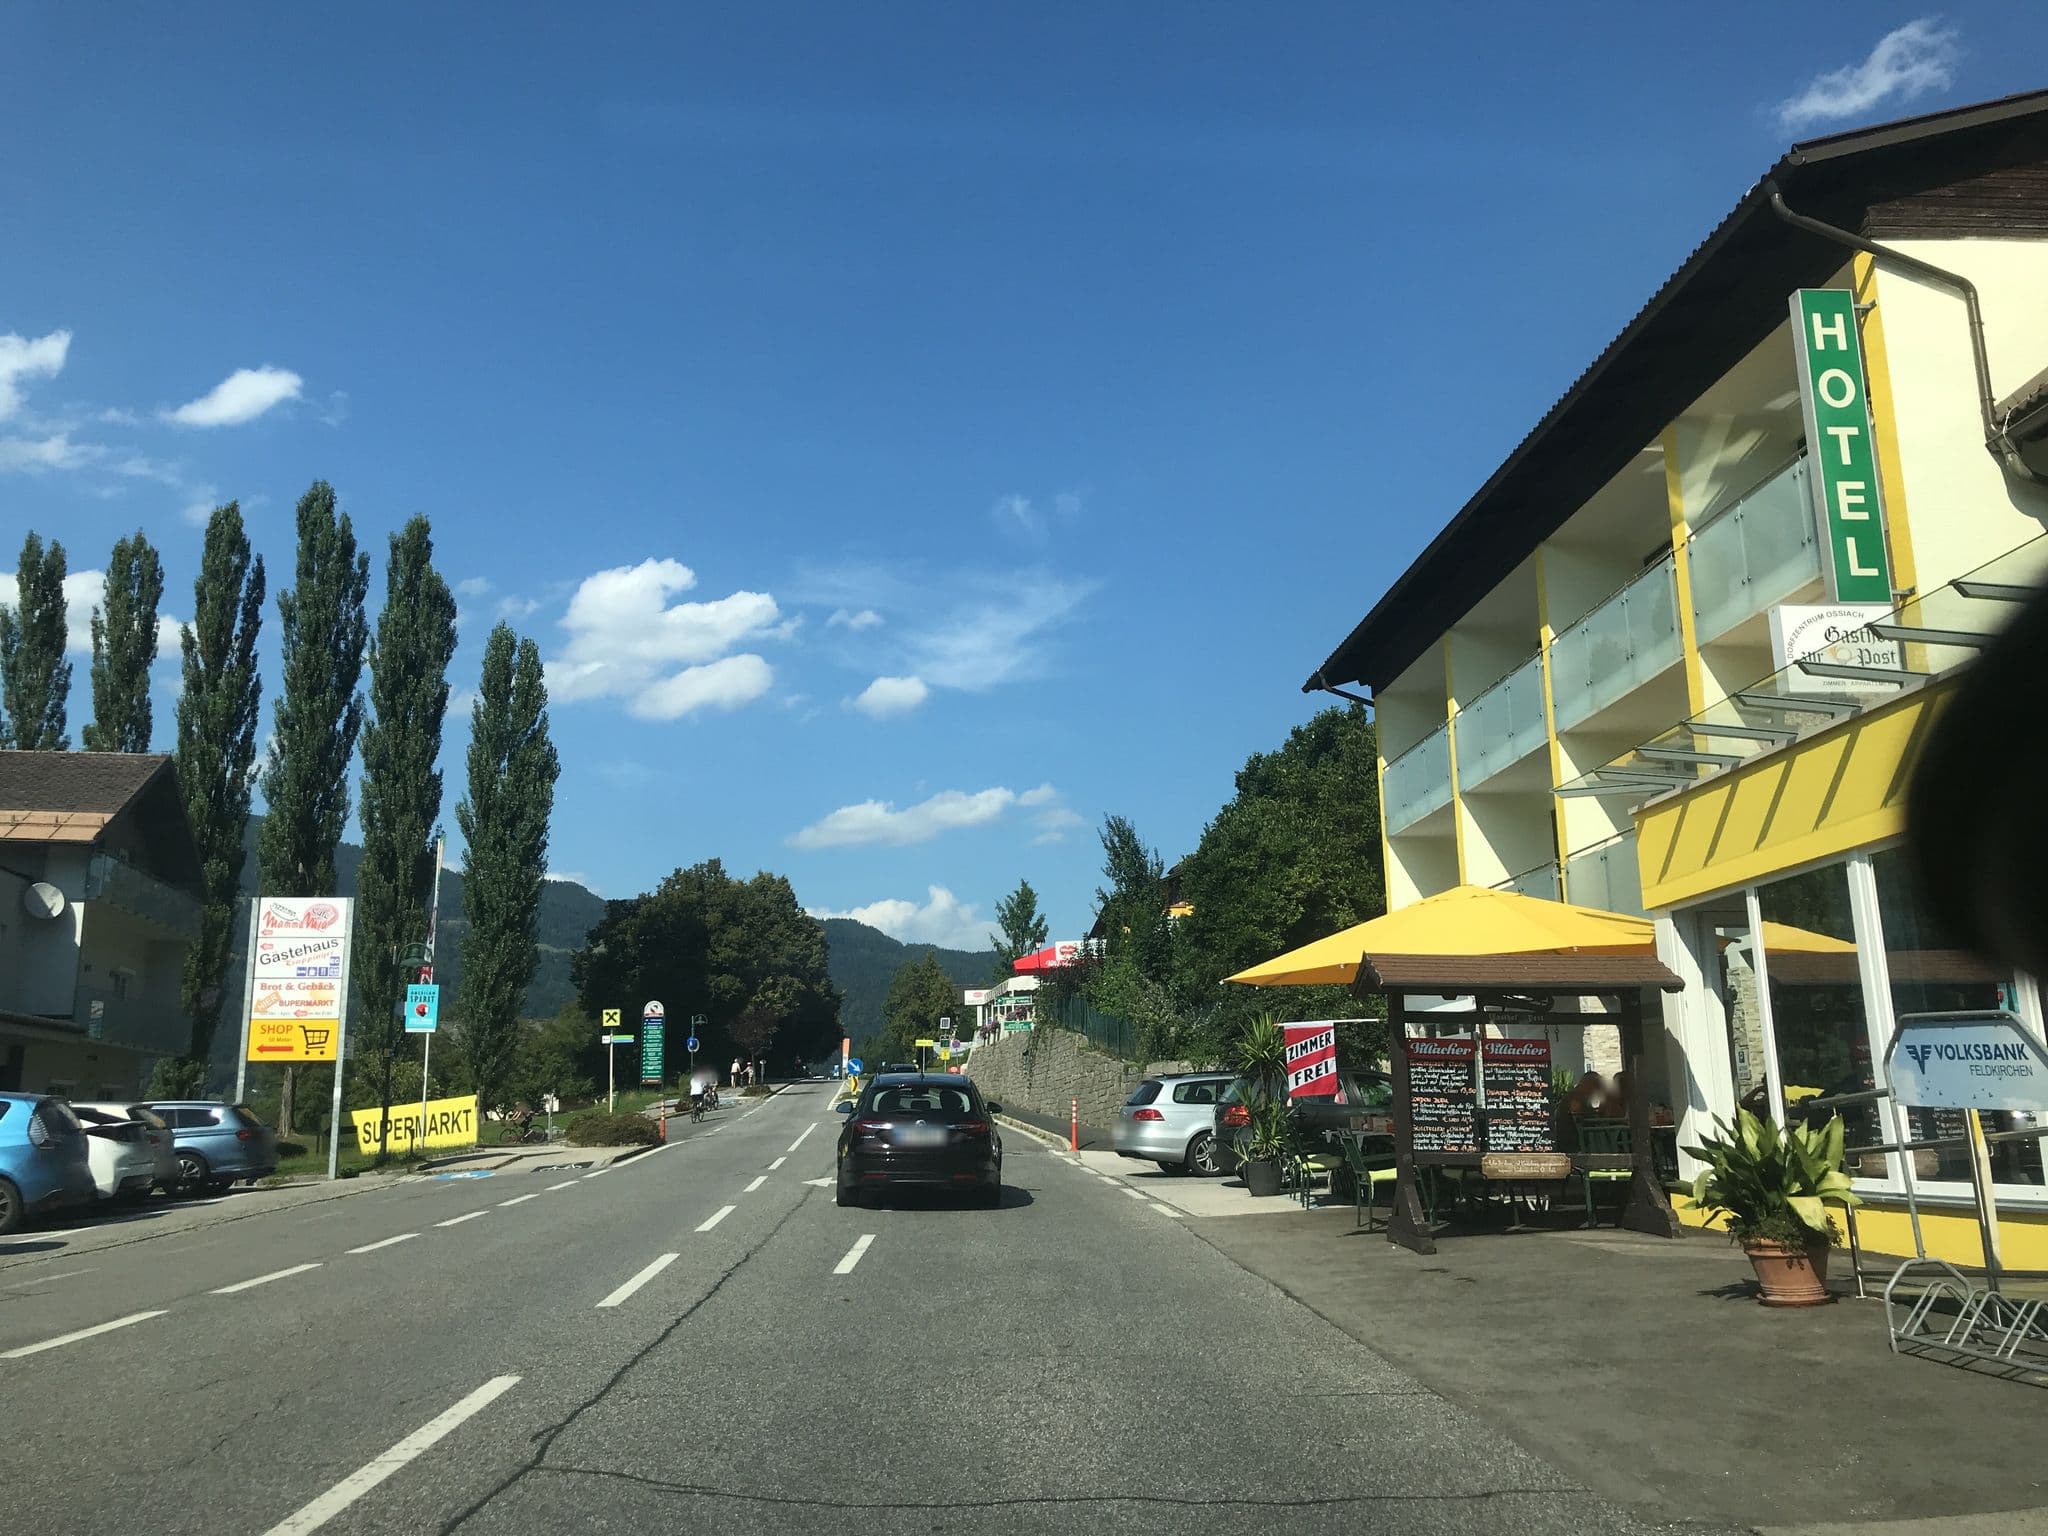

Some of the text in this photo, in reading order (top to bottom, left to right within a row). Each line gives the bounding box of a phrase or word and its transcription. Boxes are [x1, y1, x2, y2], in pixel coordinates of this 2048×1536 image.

[1811, 312, 1879, 577] HOTEL
[1787, 610, 1865, 659] DORFZENTRUM OSSIACH
[1857, 648, 1897, 666] Post
[260, 1024, 294, 1034] SHOP
[1288, 1031, 1332, 1061] ZIMMER
[1410, 1042, 1472, 1056] Villacher
[1485, 1042, 1547, 1056] Villacher
[1933, 1043, 2029, 1061] VOLKSBANK
[1294, 1061, 1330, 1087] FREI
[1969, 1064, 2033, 1077] FELDKIRCHEN
[363, 1109, 472, 1144] SUPERMARKT
